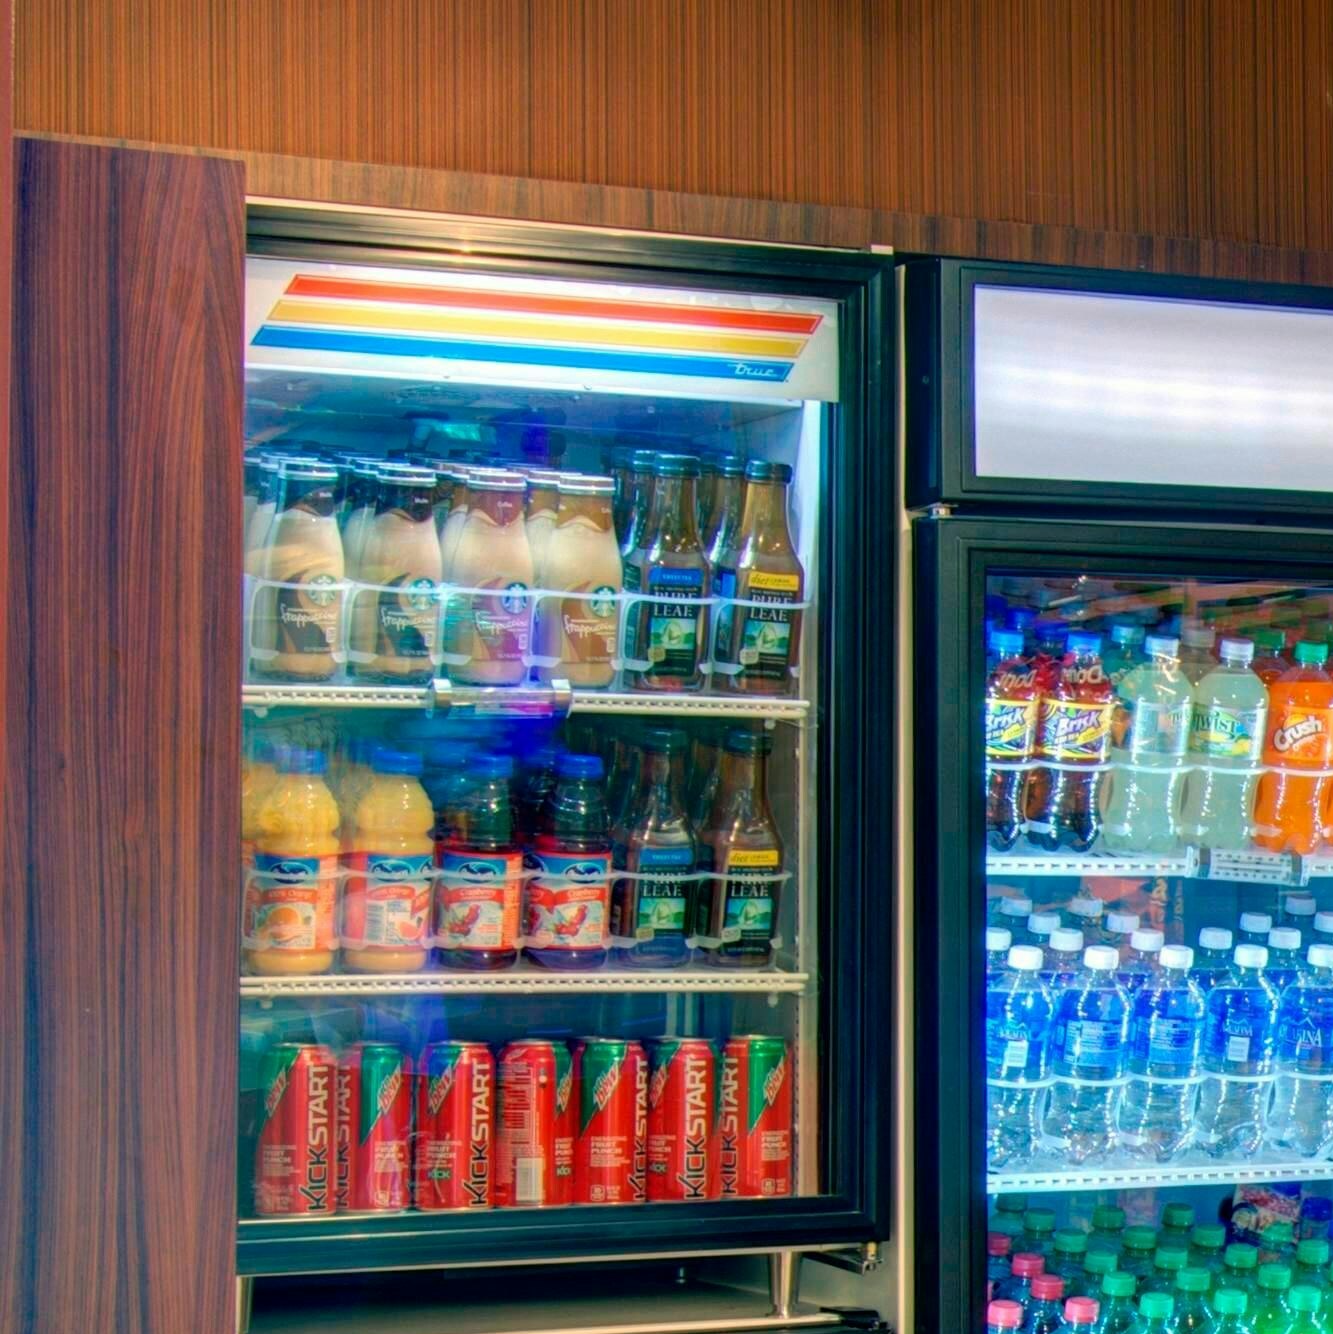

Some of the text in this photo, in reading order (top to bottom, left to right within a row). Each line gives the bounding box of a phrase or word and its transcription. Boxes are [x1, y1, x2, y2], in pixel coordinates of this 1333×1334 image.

[1057, 710, 1099, 736] Brisk
[1273, 715, 1323, 752] Crush
[299, 1063, 329, 1211] KICKSTART
[463, 1058, 491, 1206] KICKSTART
[676, 1053, 708, 1199] KICKSTART
